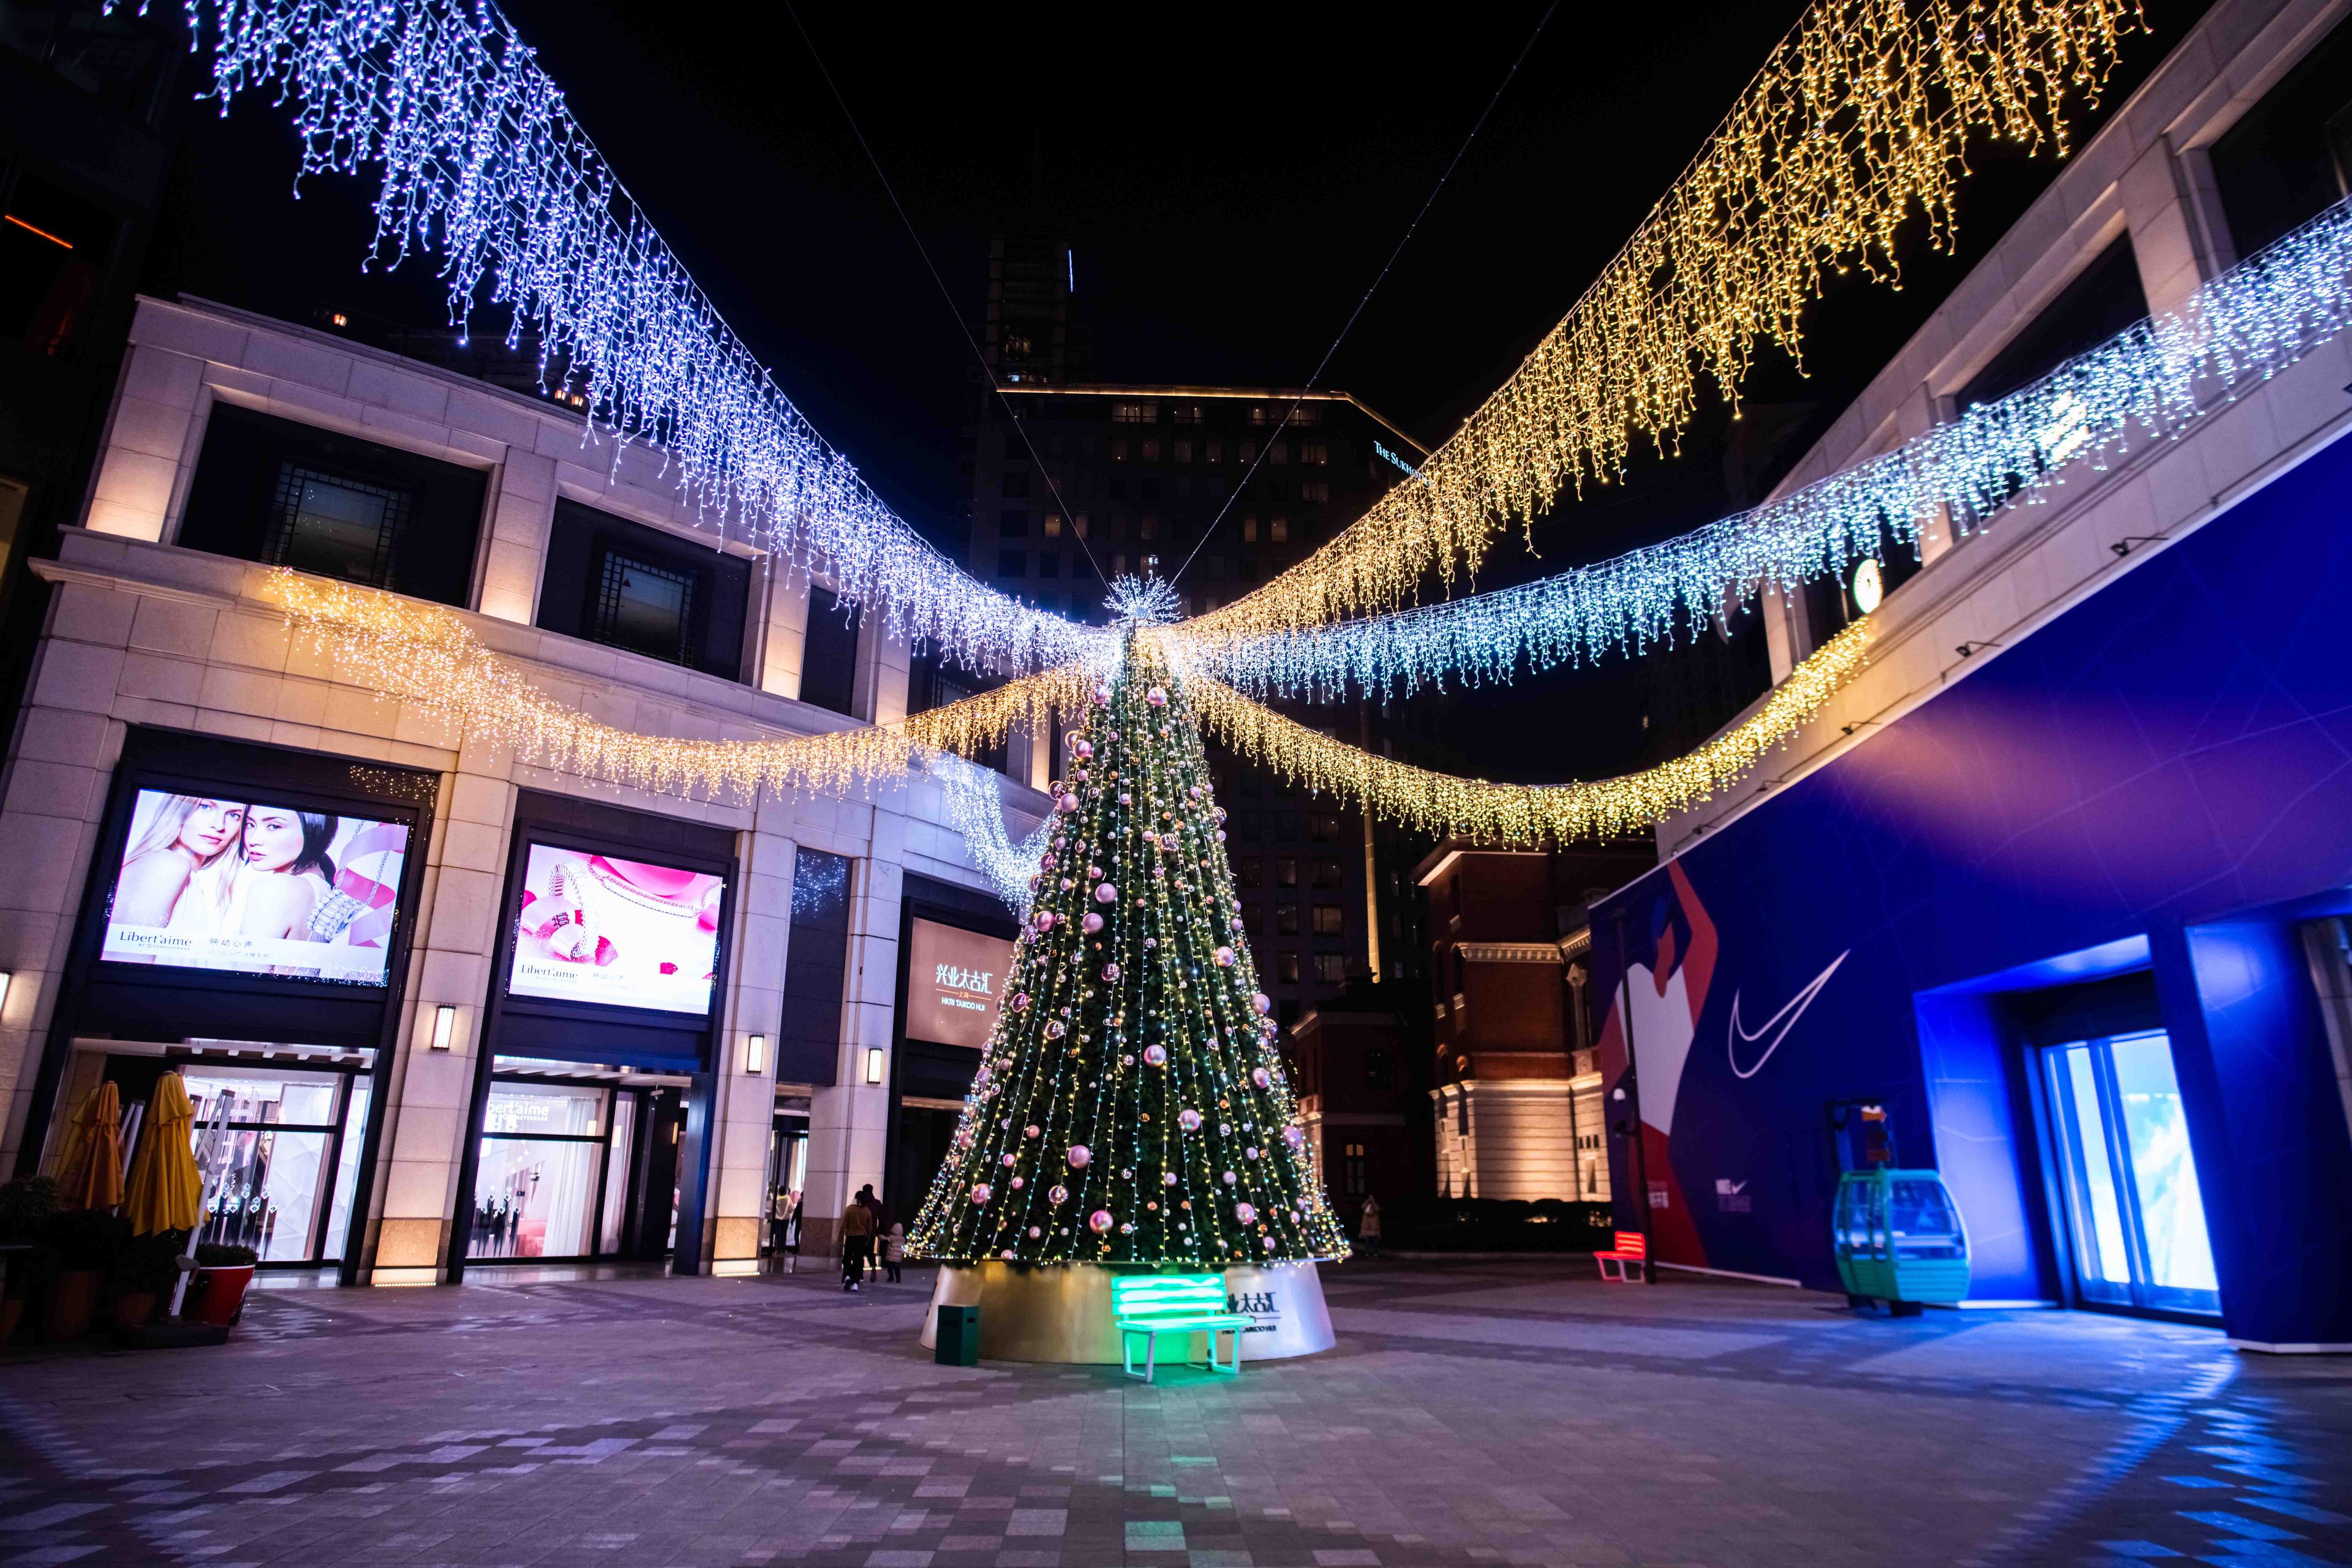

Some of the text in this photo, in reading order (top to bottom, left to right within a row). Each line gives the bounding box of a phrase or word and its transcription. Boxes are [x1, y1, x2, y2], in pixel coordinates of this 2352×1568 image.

[1373, 440, 1390, 461] THE
[936, 963, 993, 994] 兴业太古汇
[941, 997, 955, 1006] HKRI
[956, 1000, 975, 1010] TAIKOO
[1223, 1292, 1280, 1313] 业太古汇
